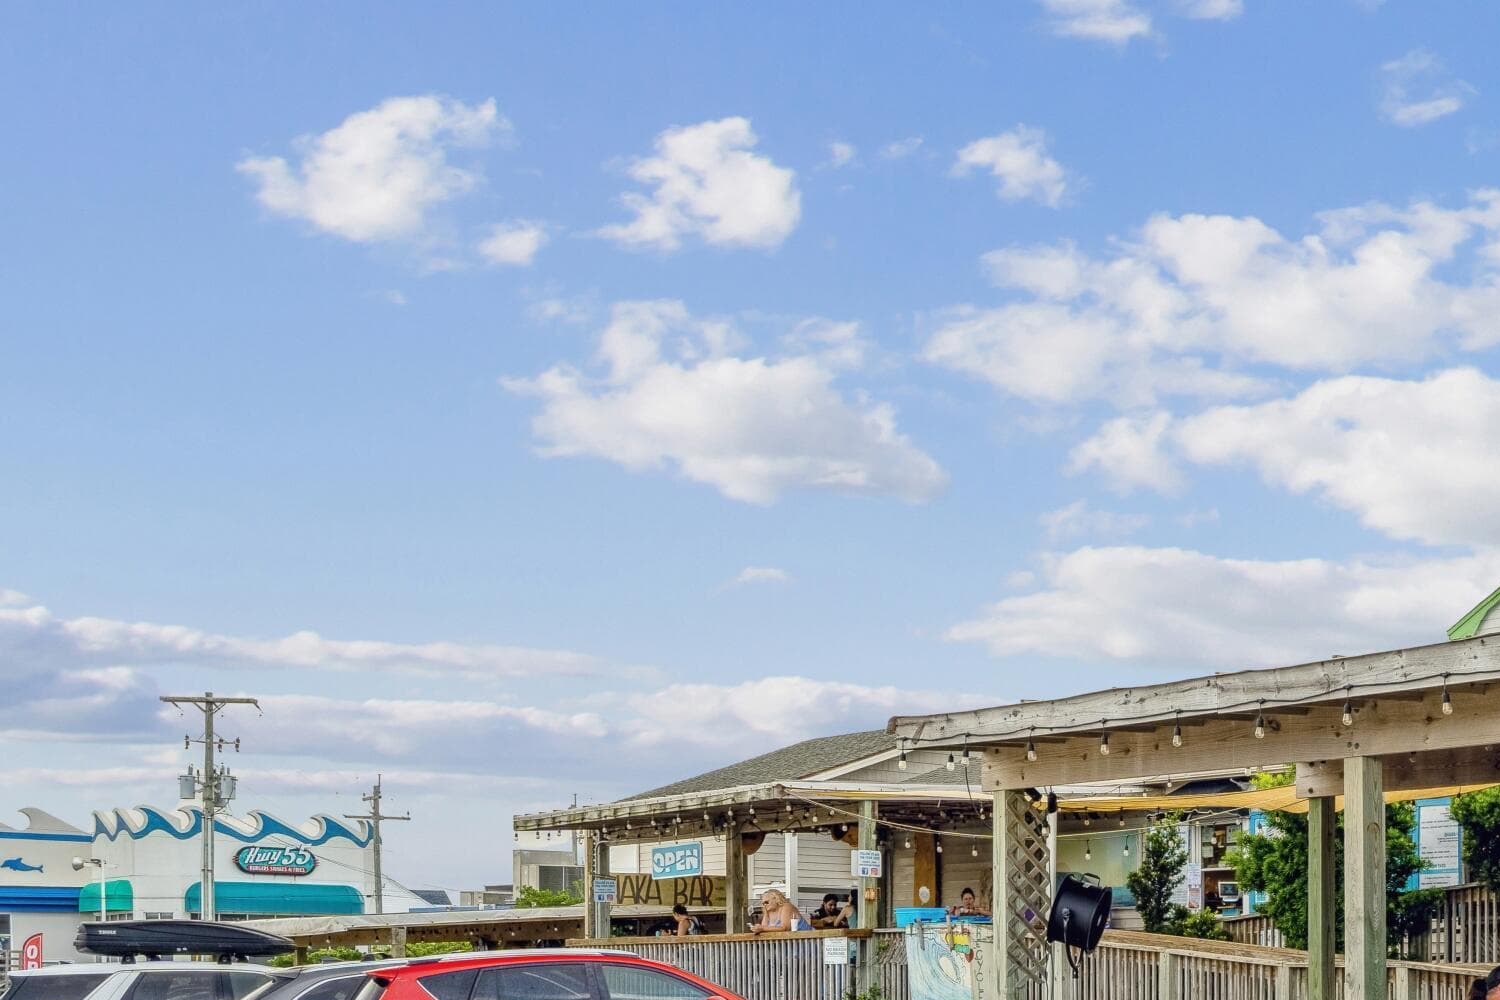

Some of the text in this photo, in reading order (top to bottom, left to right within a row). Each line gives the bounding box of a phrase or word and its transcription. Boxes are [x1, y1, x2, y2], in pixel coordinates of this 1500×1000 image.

[244, 845, 311, 866] Hwy 55
[652, 849, 699, 874] OPEN
[616, 875, 663, 905] AKA
[673, 876, 714, 907] BAR
